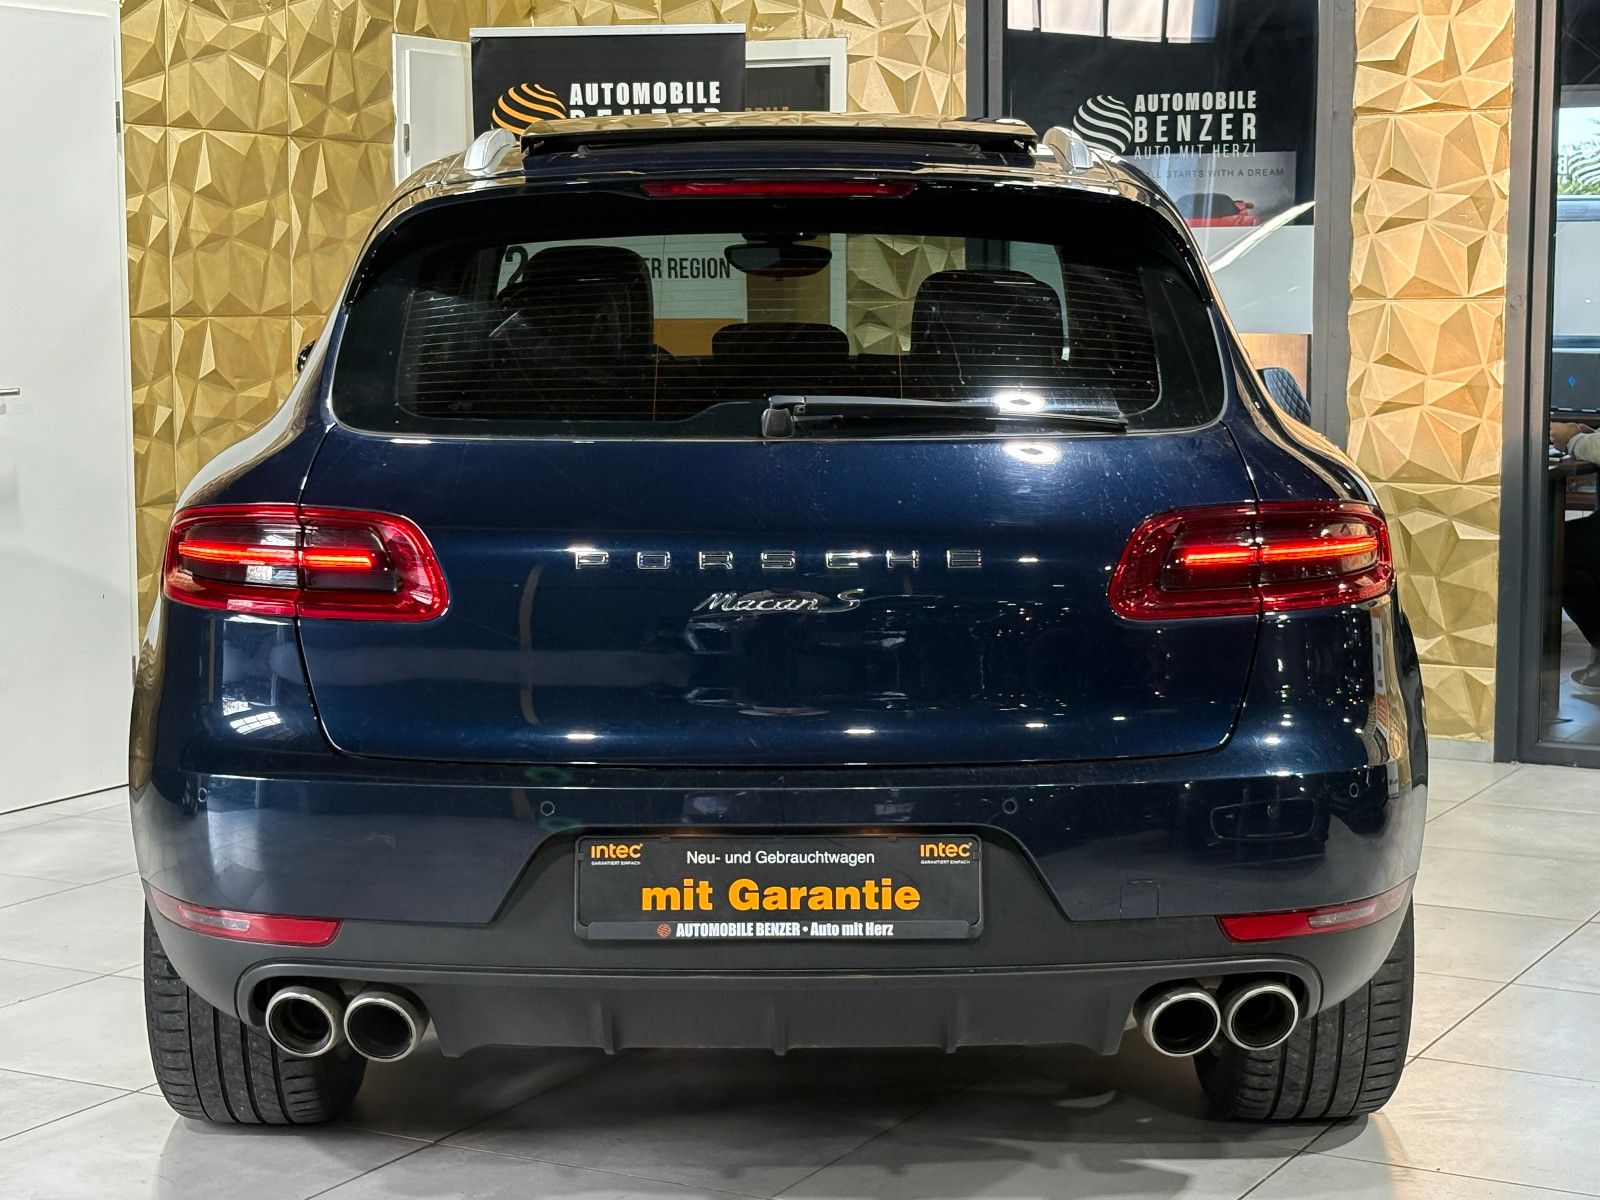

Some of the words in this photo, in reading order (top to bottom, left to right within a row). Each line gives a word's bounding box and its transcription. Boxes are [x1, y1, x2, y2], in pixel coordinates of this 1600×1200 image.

[569, 81, 721, 105] AUTOMOBILE
[1134, 90, 1257, 113] AUTOMOBILE
[1134, 112, 1257, 143] BENZER
[1134, 145, 1171, 160] AUTO
[1179, 144, 1204, 159] MIT
[1212, 143, 1256, 158] HERZ!
[1166, 169, 1205, 179] STARTS
[1237, 168, 1244, 177] A
[1247, 167, 1285, 177] DREAM
[667, 257, 731, 279] REGION
[575, 550, 982, 569] PORSCHE
[692, 592, 819, 612] Macan
[817, 588, 865, 614] S
[590, 842, 643, 859] intec
[686, 850, 721, 864] Neu-
[724, 850, 751, 864] und
[755, 850, 875, 867] Gebrauchtwagen
[919, 841, 972, 858] intec
[642, 878, 714, 911] mit
[728, 878, 921, 912] Garantie
[675, 922, 754, 938] AUTOMOBILE
[756, 922, 801, 937] BENZER
[810, 921, 840, 937] Auto
[841, 921, 864, 936] mit
[865, 921, 894, 937] Herz
